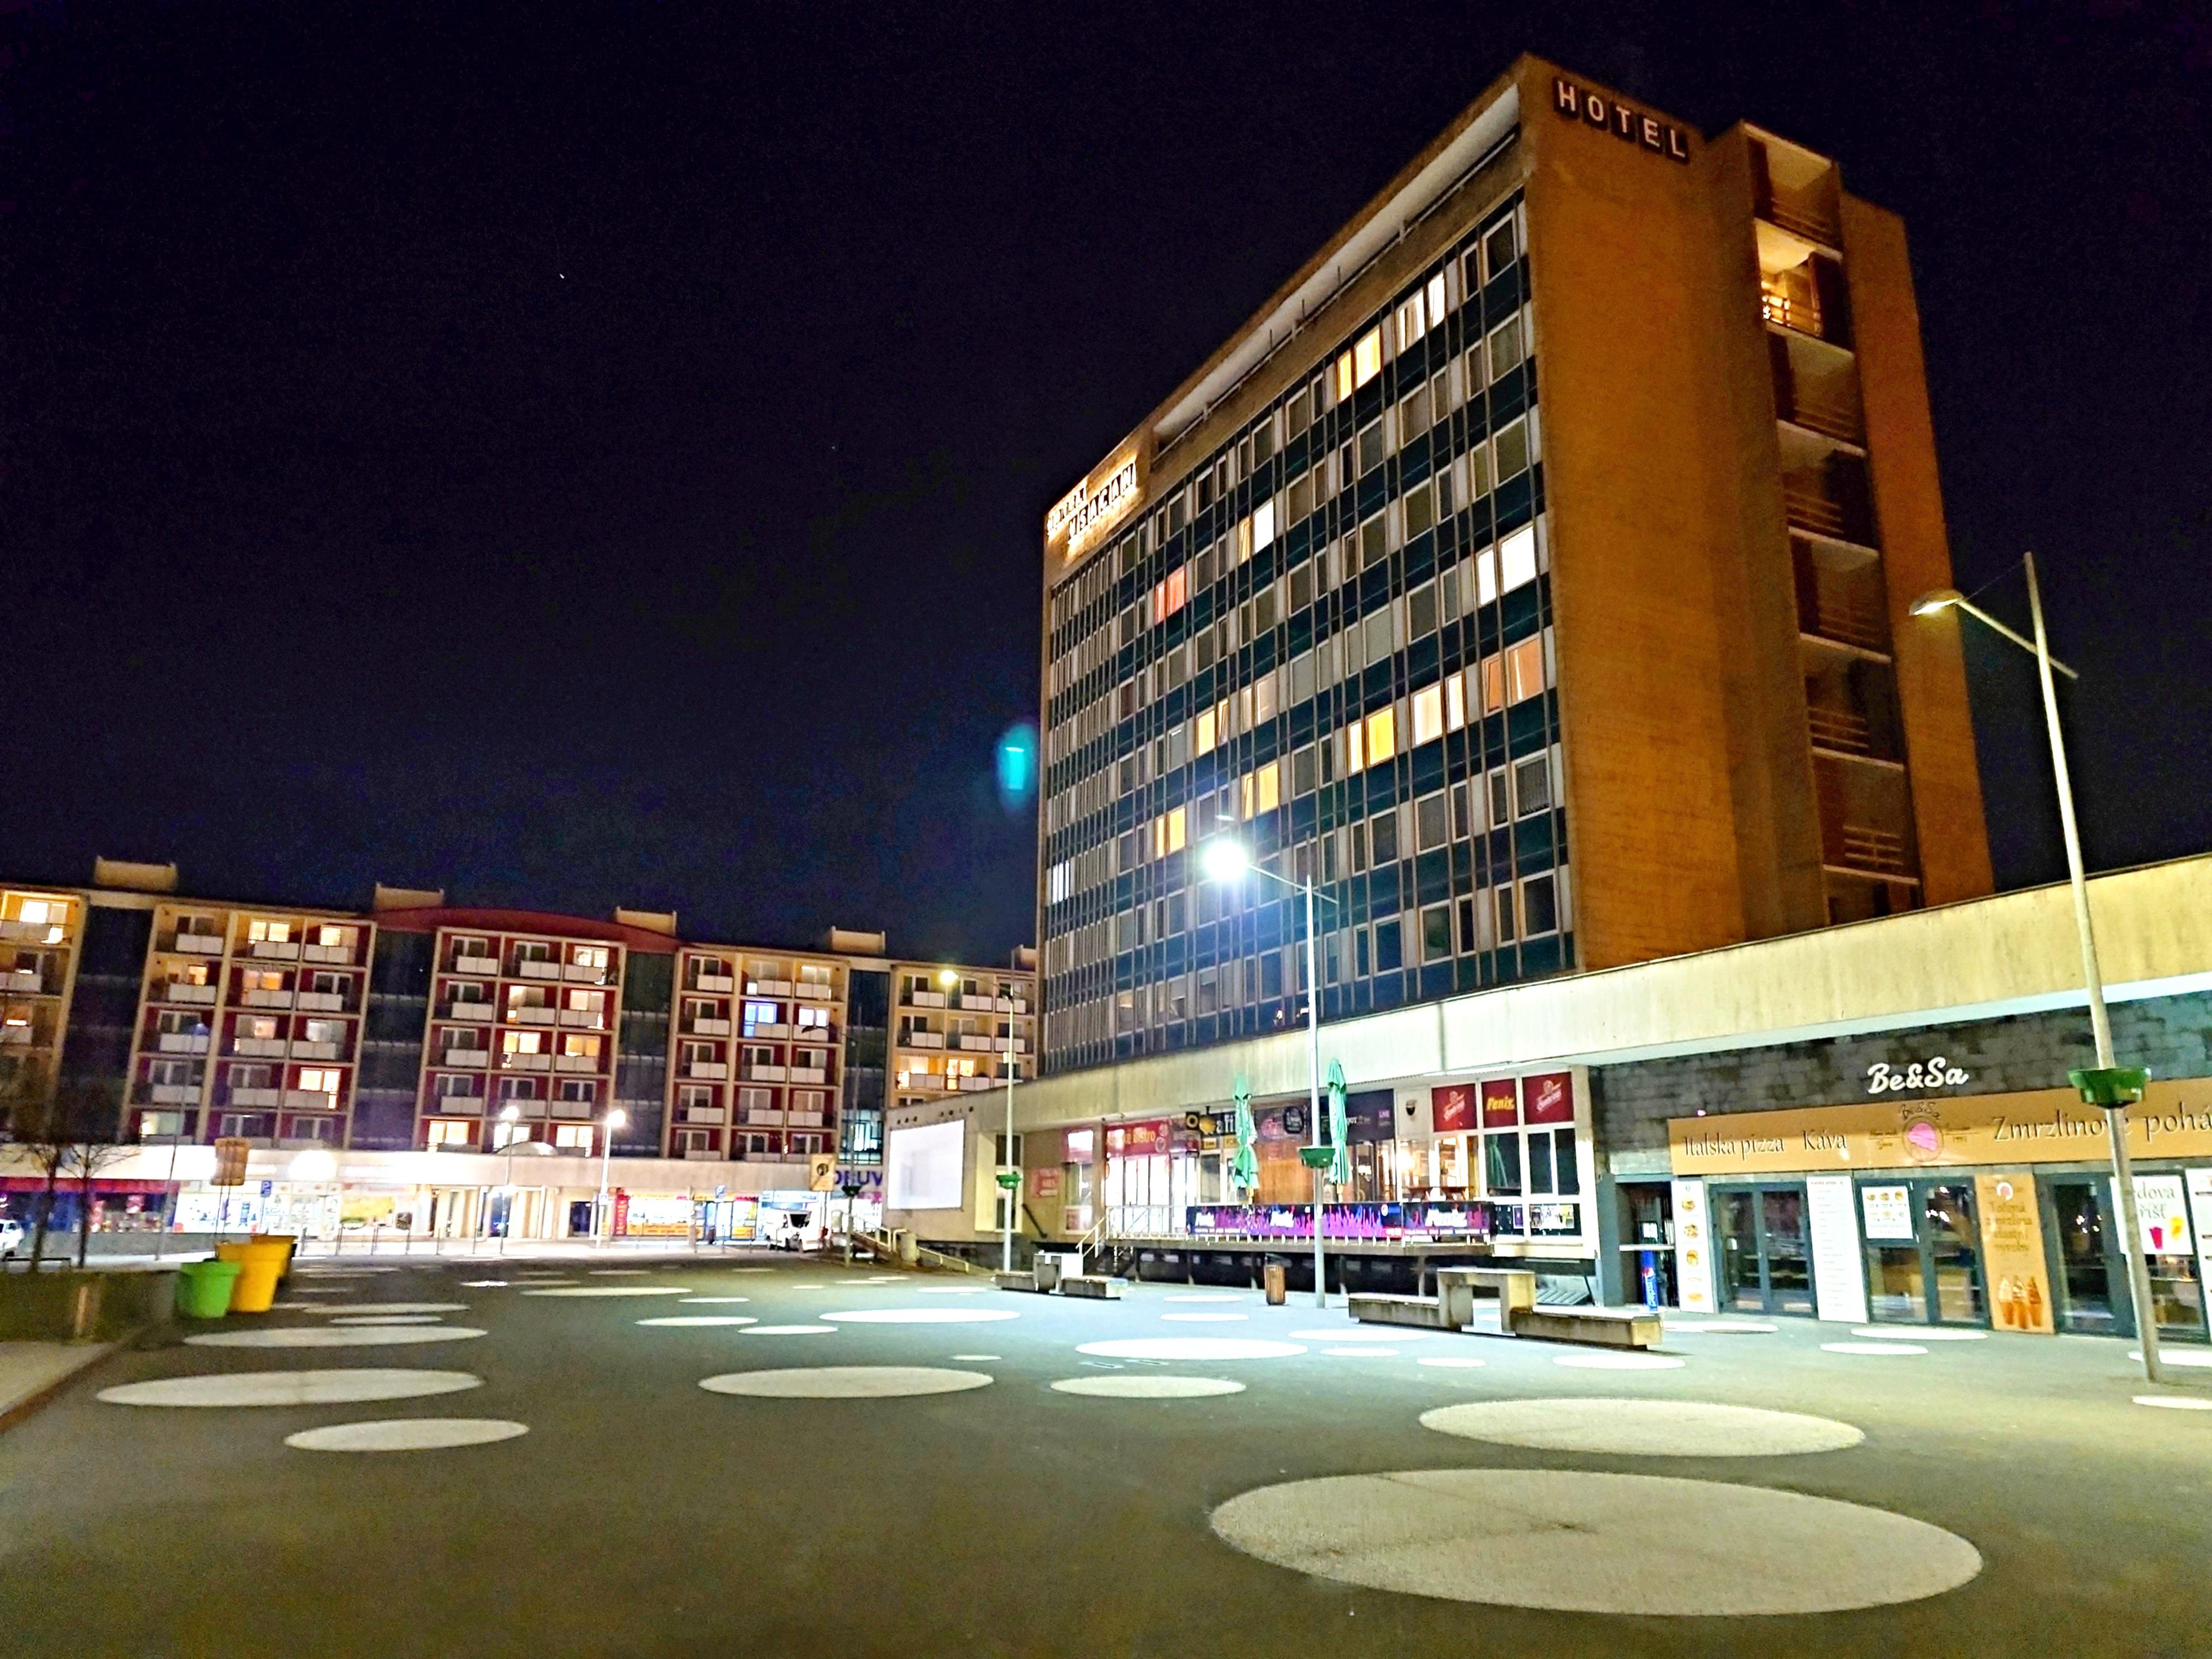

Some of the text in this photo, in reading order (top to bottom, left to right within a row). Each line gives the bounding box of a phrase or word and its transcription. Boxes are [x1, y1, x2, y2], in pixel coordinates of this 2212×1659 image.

[1557, 80, 1687, 159] HOTEL
[1867, 1056, 1969, 1094] Be&Sa
[1683, 1129, 1848, 1161] Italská pizza Káva
[2137, 1181, 2176, 1199] dová
